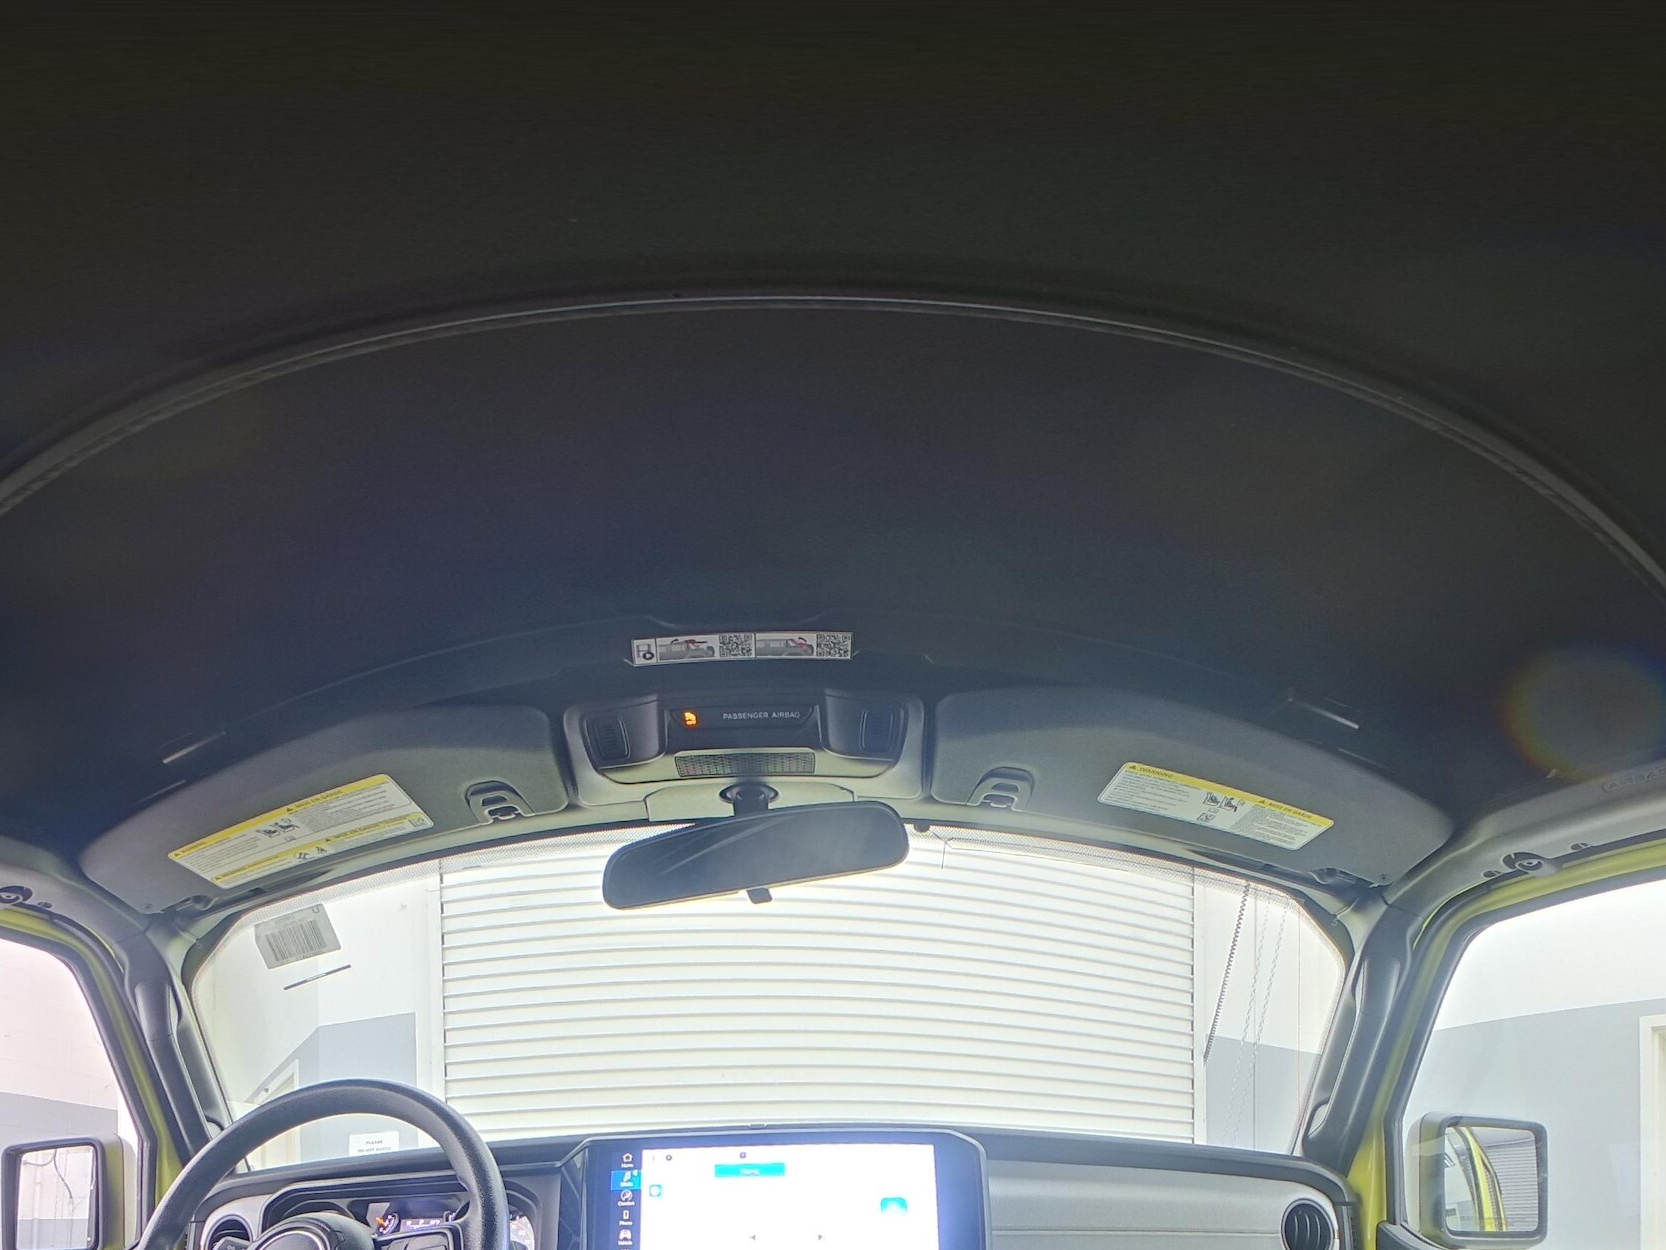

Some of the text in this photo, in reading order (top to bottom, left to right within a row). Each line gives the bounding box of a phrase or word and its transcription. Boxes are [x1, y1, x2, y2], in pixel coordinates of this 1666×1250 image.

[722, 710, 801, 721] PASSENGER AIRBAG
[1139, 766, 1174, 779] WARNING
